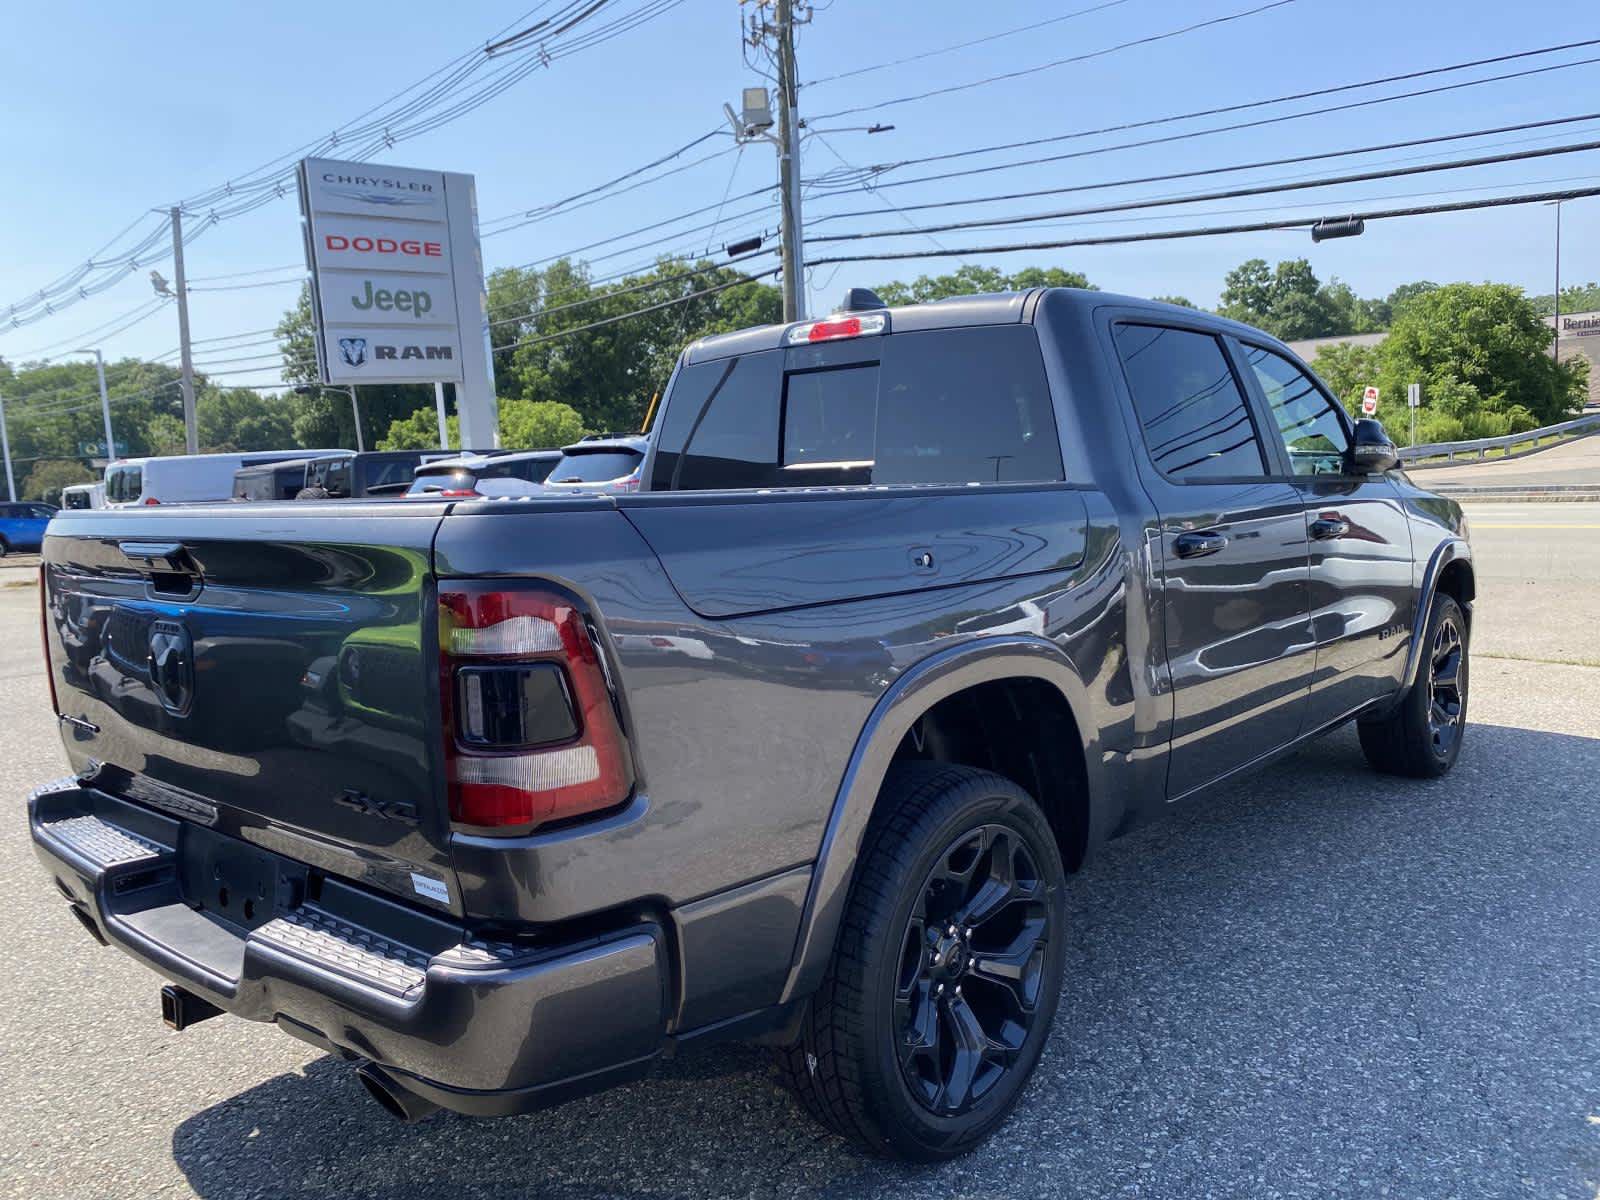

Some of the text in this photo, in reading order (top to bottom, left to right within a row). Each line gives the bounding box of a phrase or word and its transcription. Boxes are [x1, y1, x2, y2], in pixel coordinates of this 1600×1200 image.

[322, 173, 433, 193] CHRYSLER
[325, 235, 443, 257] DODGE
[351, 280, 432, 318] Jeep
[375, 345, 453, 361] RAM
